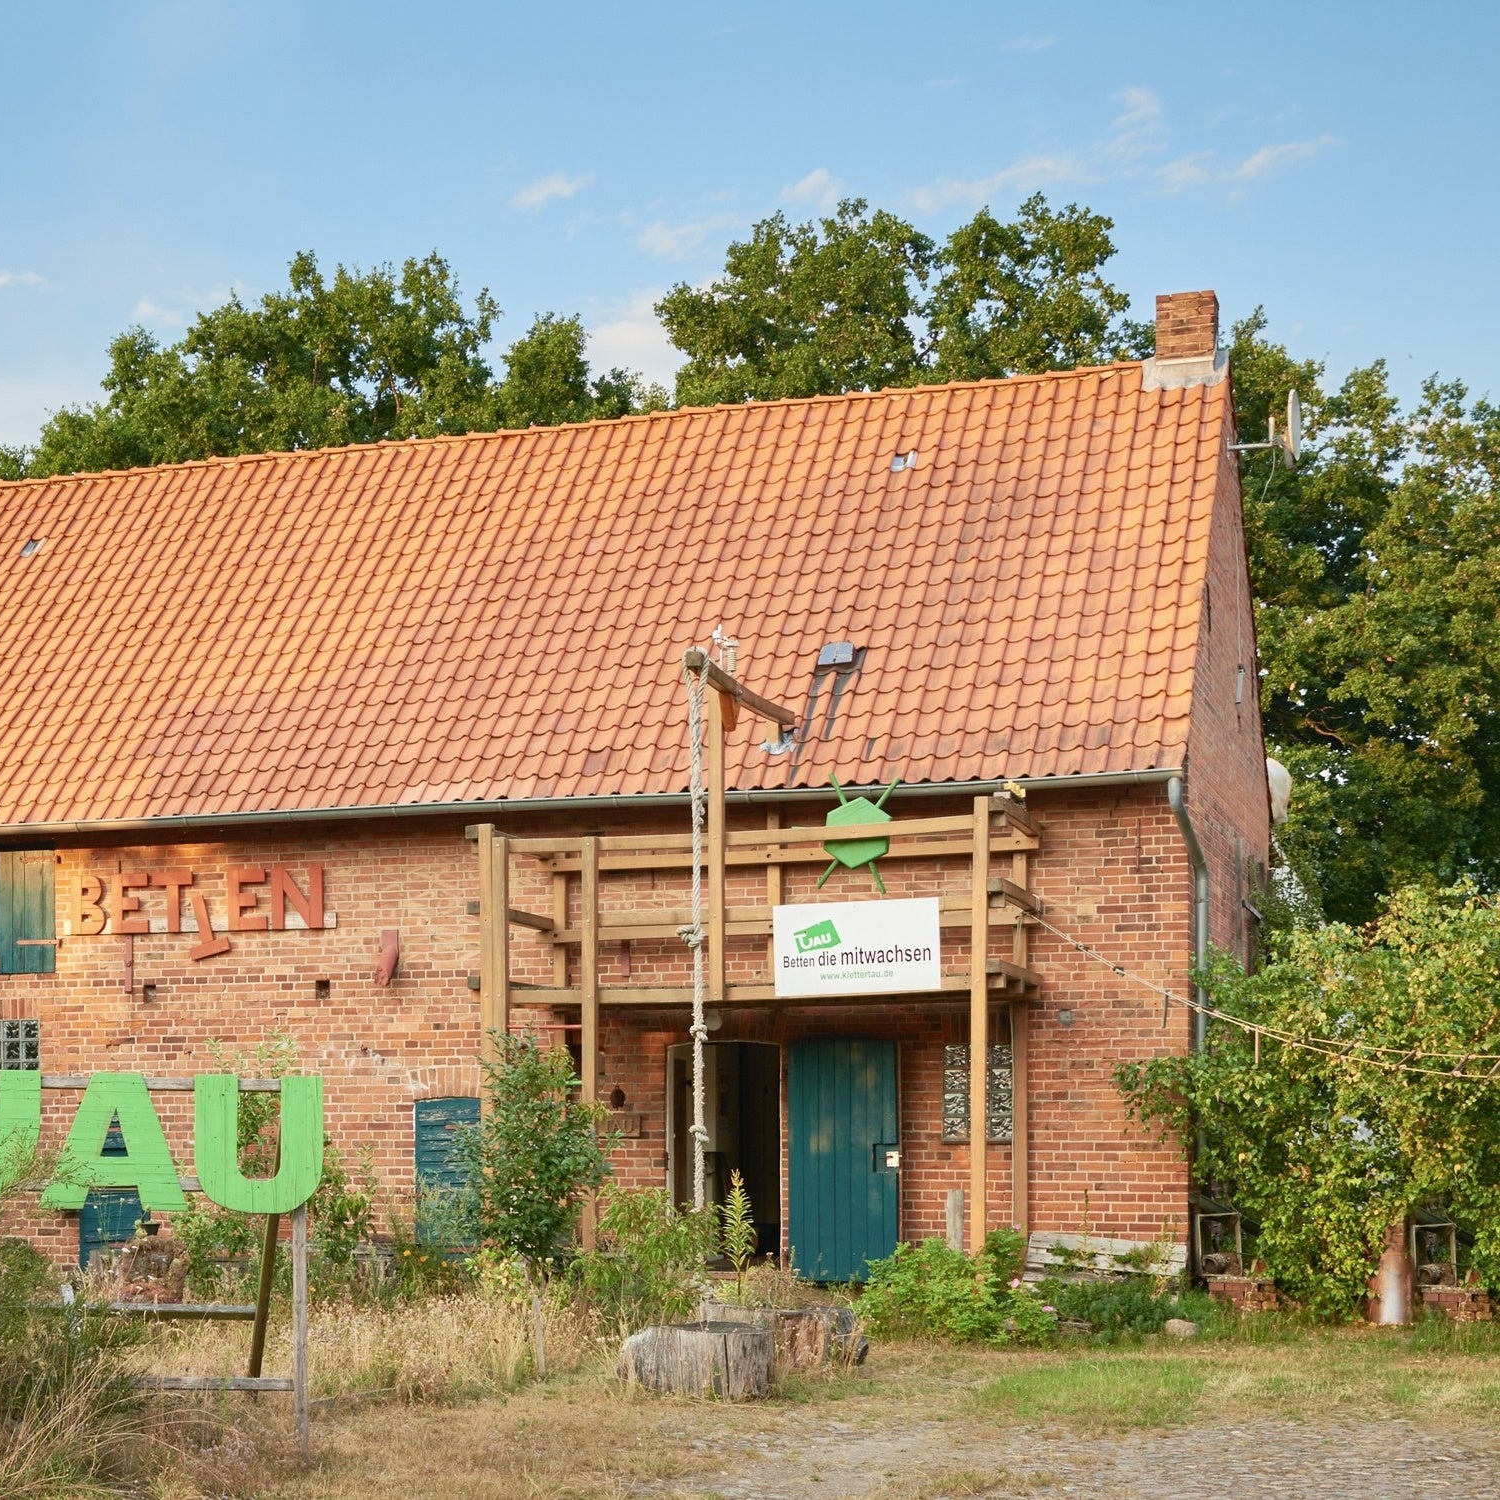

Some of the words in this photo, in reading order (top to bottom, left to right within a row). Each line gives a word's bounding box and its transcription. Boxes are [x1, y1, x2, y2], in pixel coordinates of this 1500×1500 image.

[69, 864, 324, 961] BETTEN
[783, 956, 815, 968] Betten
[818, 951, 837, 967] die
[841, 945, 932, 965] mitwachsen
[820, 970, 894, 981] www.klettertau.de
